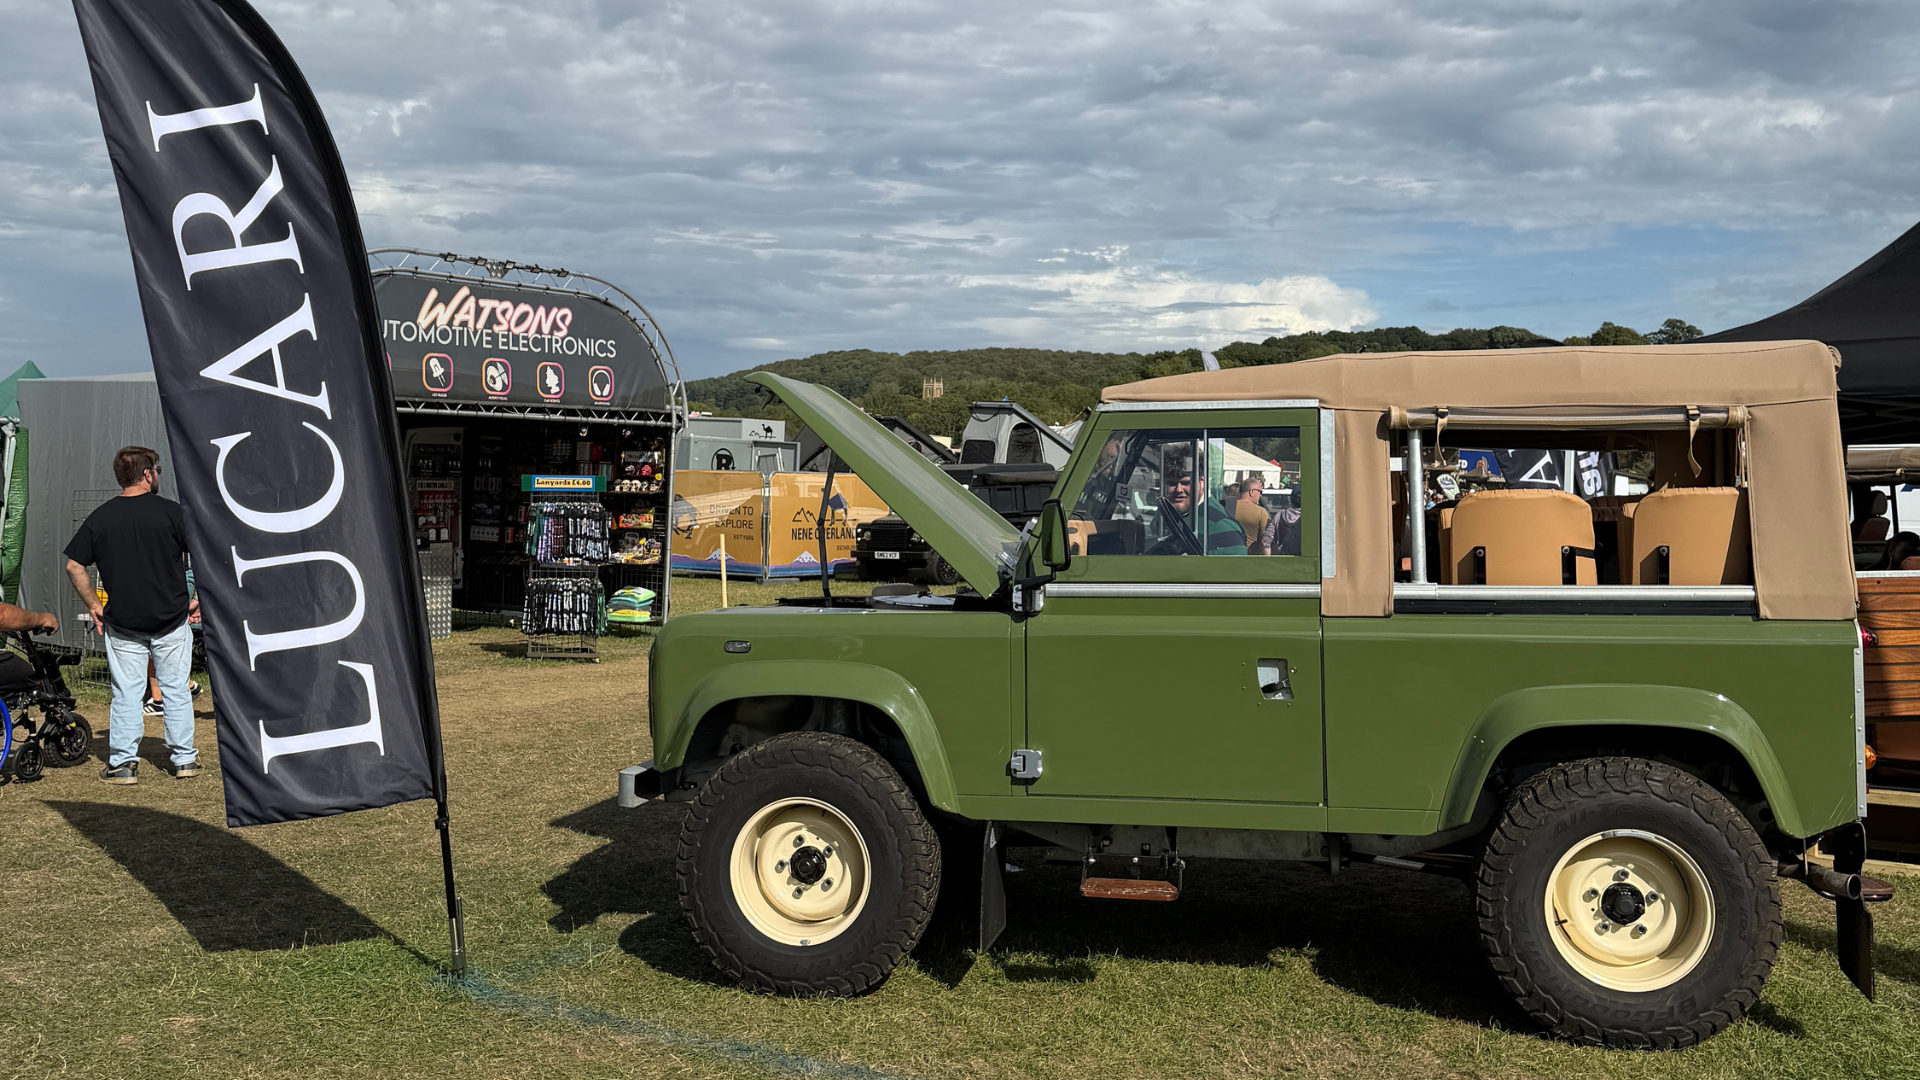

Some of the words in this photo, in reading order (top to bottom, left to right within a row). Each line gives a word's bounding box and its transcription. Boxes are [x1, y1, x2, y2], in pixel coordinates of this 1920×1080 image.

[416, 285, 573, 339] WATSONS
[383, 319, 492, 349] TOMOTIVE
[498, 330, 617, 359] ELECTRONICS
[145, 81, 385, 774] LUCARI
[709, 504, 741, 515] DRIVEN
[742, 506, 754, 516] TO
[715, 518, 754, 530] EXPLORE
[791, 528, 813, 540] NENE
[814, 527, 857, 540] OERLAND
